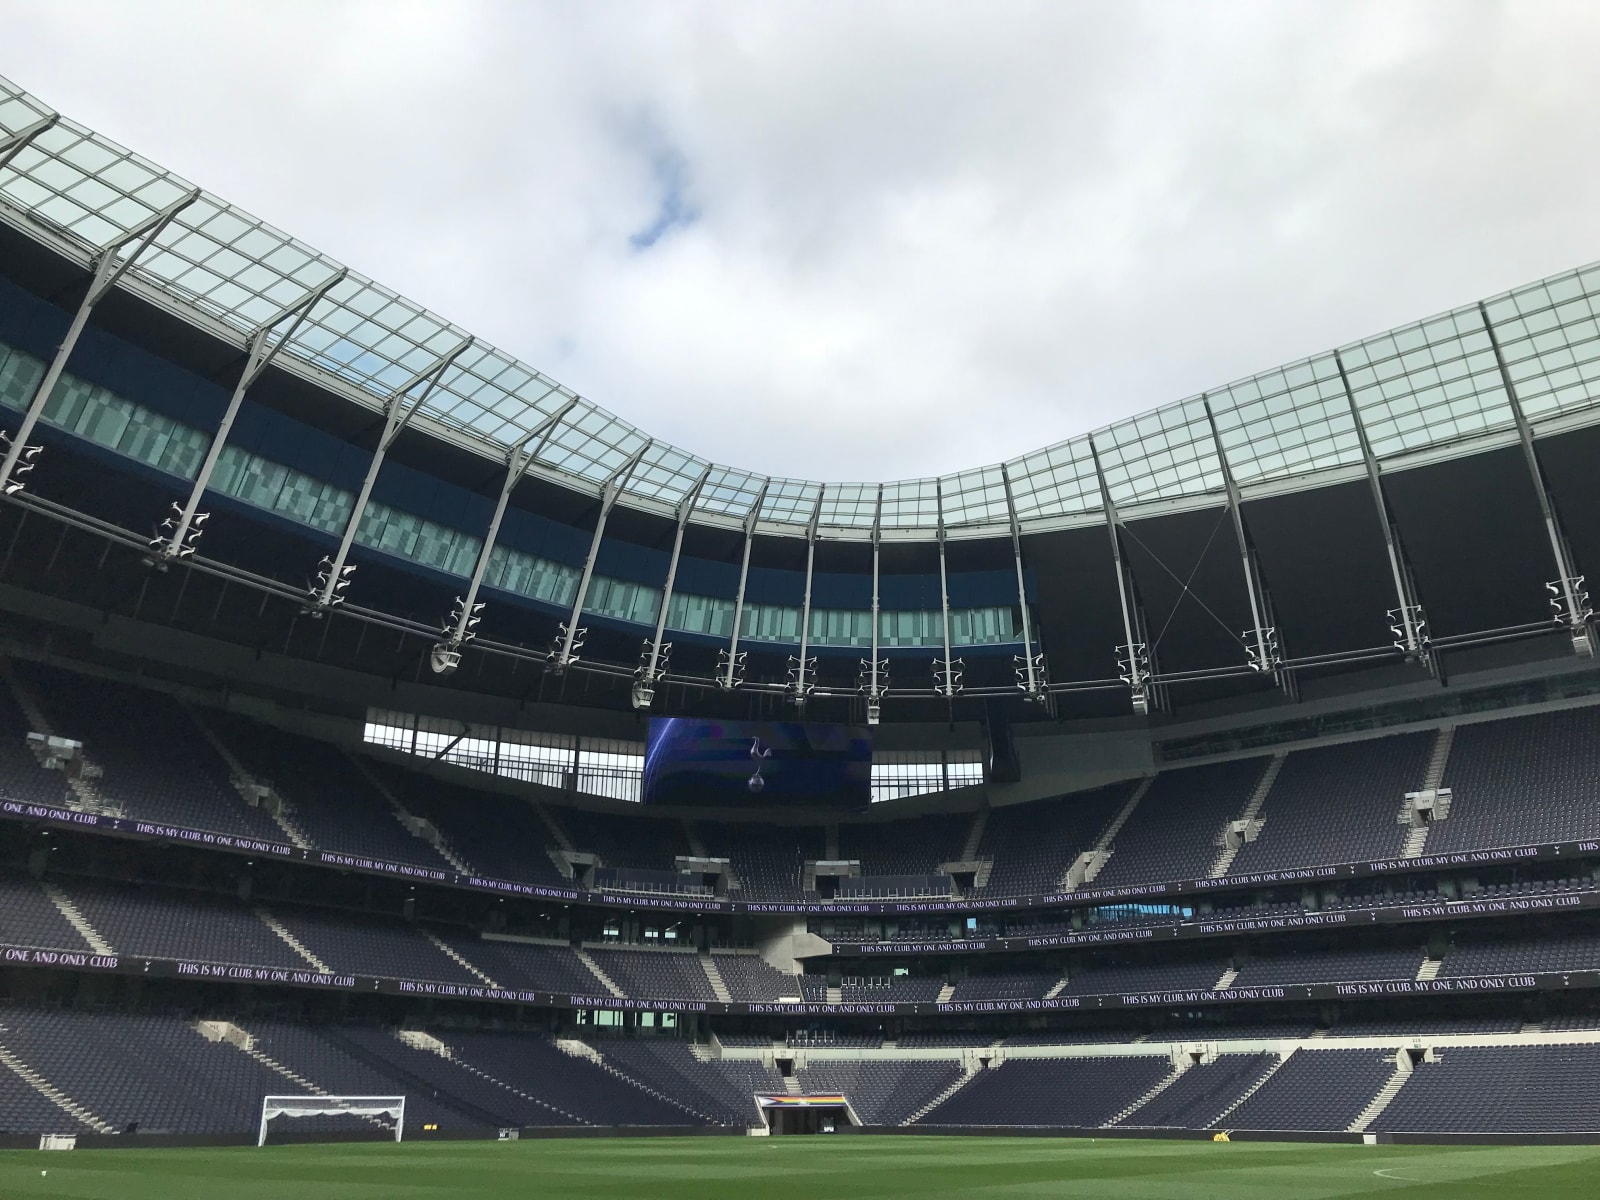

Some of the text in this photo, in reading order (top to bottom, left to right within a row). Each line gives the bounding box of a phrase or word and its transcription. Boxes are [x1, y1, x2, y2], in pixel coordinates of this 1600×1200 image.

[3, 802, 24, 813] ONE
[26, 805, 47, 817] AND
[48, 809, 72, 821] ONLY
[73, 813, 97, 825] CLUB
[136, 822, 155, 833] THIS
[156, 825, 165, 835] IS
[165, 827, 179, 837] MY
[203, 833, 216, 843] MY
[217, 835, 232, 845] ONE
[234, 838, 251, 848] AND
[252, 841, 271, 851] ONLY
[272, 844, 291, 854] CLUB
[1578, 841, 1598, 851] THIS
[1370, 861, 1387, 870] THIS
[1397, 859, 1410, 868] MY
[1435, 855, 1449, 864] MY
[1450, 854, 1468, 863] ONE
[1470, 852, 1489, 861] AND
[1490, 849, 1513, 859] ONLY
[1514, 847, 1537, 856] CLUB
[1195, 879, 1210, 888] THIS
[1219, 877, 1230, 885] MY
[1250, 874, 1262, 882] MY
[1263, 872, 1279, 881] ONE
[1279, 871, 1295, 879] AND
[1296, 869, 1315, 878] ONLY
[1316, 867, 1336, 876] CLUB
[1403, 908, 1421, 917] THIS
[1422, 907, 1431, 915] IS
[1432, 906, 1445, 915] MY
[1472, 903, 1486, 912] MY
[1488, 901, 1506, 910] ONE
[1509, 900, 1529, 909] AND
[1530, 898, 1554, 907] ONLY
[1555, 896, 1580, 905] CLUB
[1200, 924, 1214, 932] THIS
[1216, 923, 1222, 931] IS
[1224, 922, 1234, 930] MY
[1257, 920, 1268, 928] MY
[1270, 918, 1285, 927] ONE
[1287, 917, 1303, 925] AND
[1305, 915, 1323, 924] ONLY
[1325, 914, 1346, 922] CLUB
[1028, 938, 1041, 946] THIS
[1088, 933, 1102, 941] ONE
[1103, 932, 1117, 940] AND
[1117, 931, 1134, 939] ONLY
[1135, 929, 1152, 937] CLUB
[5, 948, 30, 961] ONE
[31, 951, 58, 963] AND
[58, 953, 88, 965] ONLY
[89, 955, 118, 968] CLUB
[178, 962, 199, 974] THIS
[200, 964, 210, 974] IS
[211, 965, 226, 976] MY
[254, 969, 269, 979] MY
[270, 970, 289, 981] ONE
[290, 972, 310, 982] AND
[311, 974, 333, 984] ONLY
[333, 975, 355, 986] CLUB
[399, 981, 416, 991] THIS
[416, 982, 424, 991] IS
[424, 983, 436, 992] MY
[457, 986, 468, 995] MY
[469, 987, 485, 996] ONE
[485, 989, 500, 998] AND
[500, 990, 517, 999] ONLY
[518, 991, 535, 1001] CLUB
[1337, 984, 1356, 994] THIS
[1358, 984, 1367, 993] IS
[1369, 983, 1384, 993] MY
[1414, 981, 1429, 991] MY
[1432, 980, 1452, 990] ONE
[1455, 979, 1477, 989] AND
[1479, 978, 1505, 988] ONLY
[1508, 976, 1535, 987] CLUB
[570, 996, 585, 1004] THIS
[585, 997, 592, 1005] IS
[593, 997, 603, 1005] MY
[624, 999, 635, 1007] MY
[636, 1000, 651, 1008] ONE
[652, 1000, 667, 1009] AND
[668, 1001, 686, 1010] ONLY
[688, 1002, 706, 1010] CLUB
[938, 1003, 953, 1011] THIS
[955, 1003, 961, 1011] IS
[996, 1001, 1007, 1009] MY
[1009, 1001, 1024, 1009] ONE
[1025, 1000, 1040, 1008] AND
[1041, 999, 1059, 1008] ONLY
[1061, 998, 1079, 1007] CLUB
[1123, 995, 1139, 1004] THIS
[1140, 994, 1147, 1003] IS
[1149, 994, 1160, 1002] MY
[1186, 992, 1198, 1001] MY
[1200, 991, 1217, 1000] ONE
[1219, 990, 1237, 999] AND
[1238, 989, 1259, 998] ONLY
[1262, 988, 1284, 997] CLUB
[808, 1004, 819, 1012] MY
[821, 1004, 837, 1012] ONE
